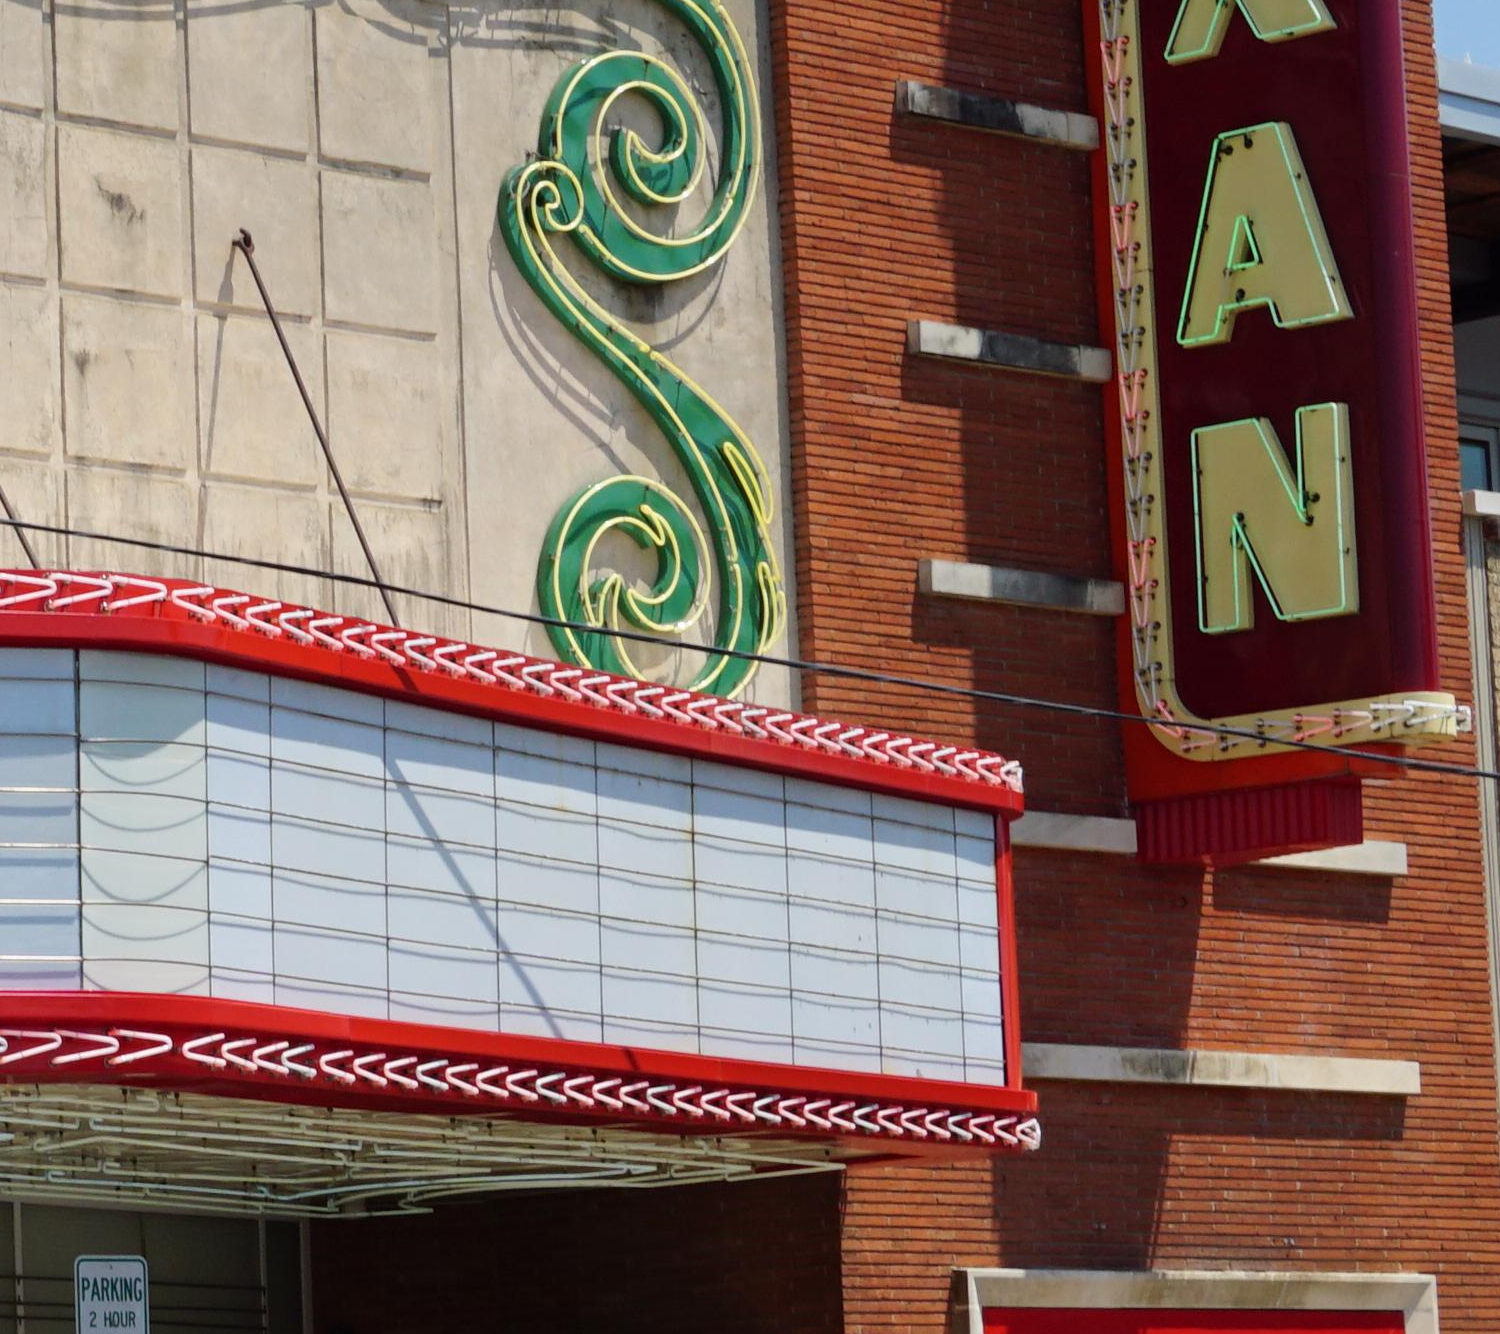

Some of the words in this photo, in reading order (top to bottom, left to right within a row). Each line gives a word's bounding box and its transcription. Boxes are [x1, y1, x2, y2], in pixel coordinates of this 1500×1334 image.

[81, 1277, 143, 1302] PARKING
[89, 1311, 97, 1328] 2
[104, 1310, 136, 1328] HOUR
